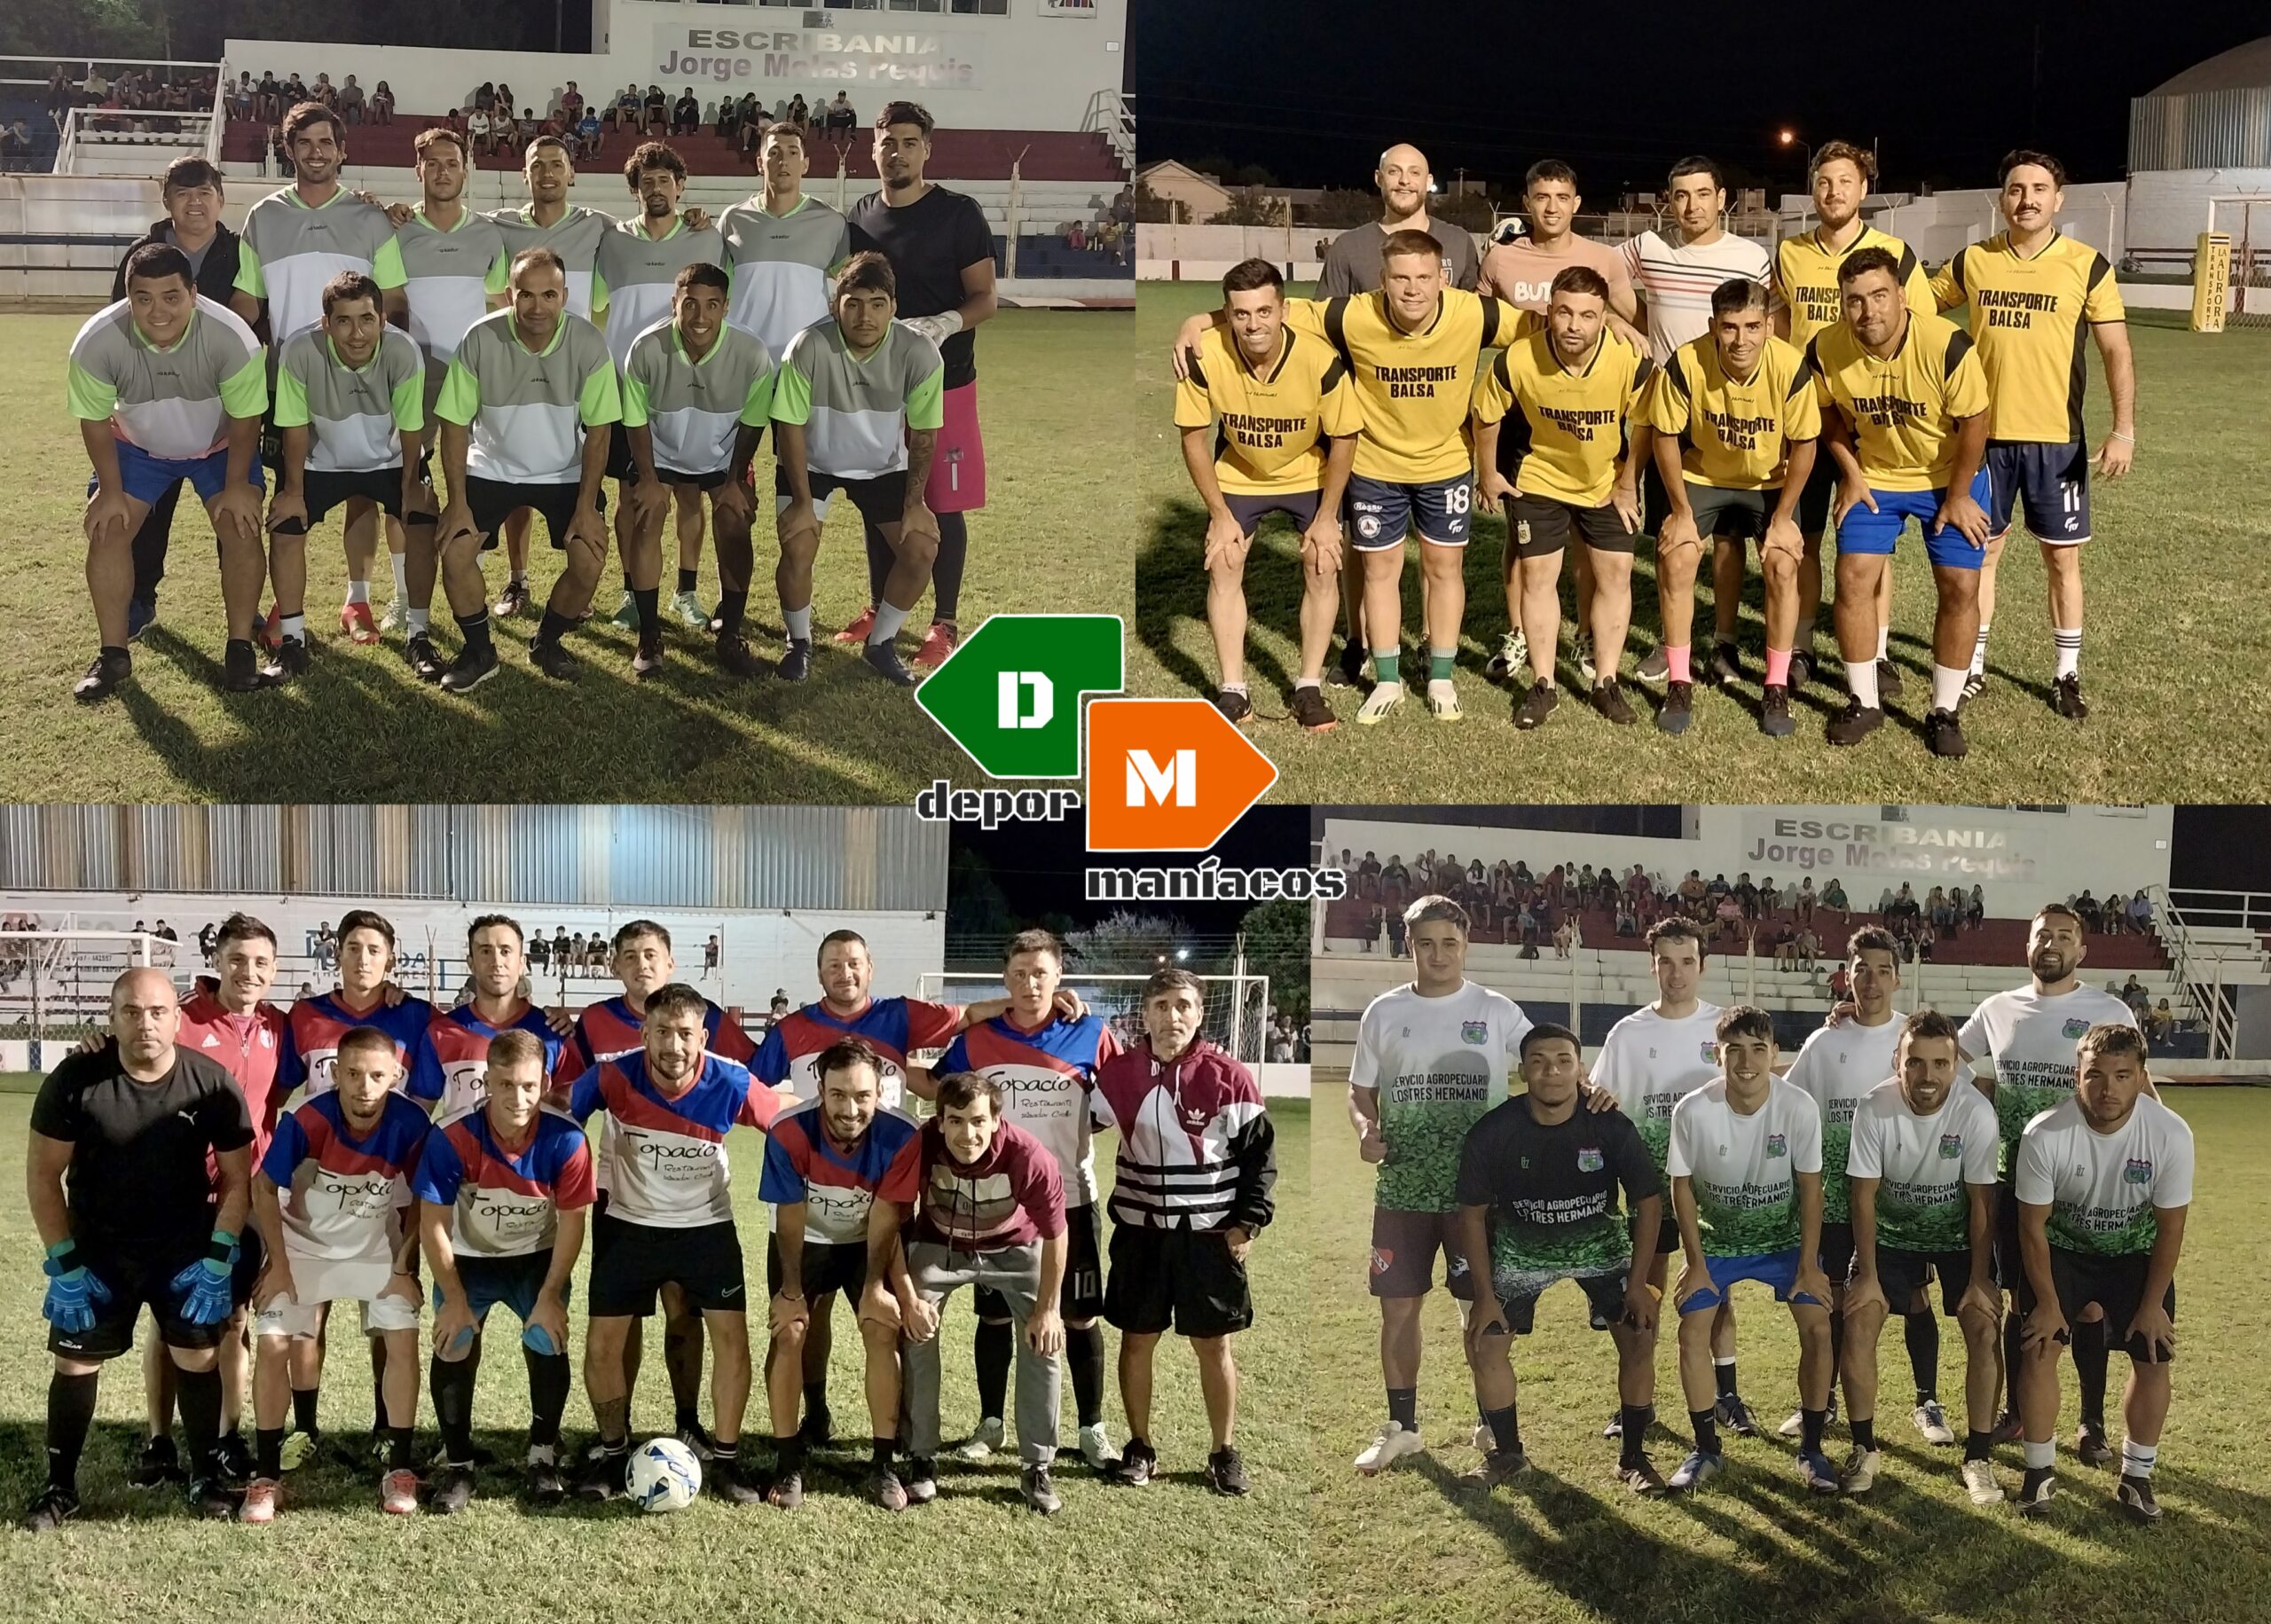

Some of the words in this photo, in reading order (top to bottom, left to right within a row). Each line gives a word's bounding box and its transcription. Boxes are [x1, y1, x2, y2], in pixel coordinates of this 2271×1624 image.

[688, 29, 943, 54] ESCRIBANIA
[659, 51, 751, 82] Jorge
[2218, 248, 2227, 257] LA
[1796, 286, 1840, 303] TRANSP
[1978, 289, 2058, 312] TRANSPORTE
[2213, 259, 2225, 329] AURORA
[1807, 303, 1839, 322] BALS
[1989, 309, 2031, 329] BALSA
[1373, 365, 1457, 382] TRANSPORTE
[1391, 383, 1434, 398] BALSA
[1222, 412, 1307, 433] TRANSPORTE
[1537, 405, 1615, 426] TRANSPORTE
[1703, 409, 1775, 435] TRANSPORTE
[1238, 431, 1283, 448] BALSA
[1557, 421, 1593, 442] BALSA
[1717, 428, 1756, 450] BALSA
[1444, 484, 1470, 514] 18
[2060, 481, 2080, 513] 11
[1774, 819, 2008, 849] ESCRIBANIA
[1748, 838, 1835, 869] Jorge
[2022, 1062, 2076, 1076] AGROPECUAR
[1391, 1074, 1424, 1088] ERVCIO
[2006, 1072, 2025, 1086] TRES
[2028, 1074, 2077, 1089] HERMANO
[1409, 1087, 1432, 1101] TRES
[1435, 1087, 1488, 1101] HERMANOS
[1656, 1105, 1674, 1118] TRE
[1827, 1110, 1841, 1123] LOS
[1843, 1110, 1854, 1122] TR
[624, 1131, 717, 1171] Topacio
[1741, 1179, 1791, 1196] AGOPECUARIO
[1912, 1180, 1959, 1195] GROPECUAR
[1915, 1189, 1960, 1205] HERMANO
[1547, 1189, 1607, 1212] AGROPECUARIO
[1530, 1210, 1554, 1224] TRES
[2094, 1212, 2137, 1231] HERMN
[1074, 1270, 1096, 1300] 10
